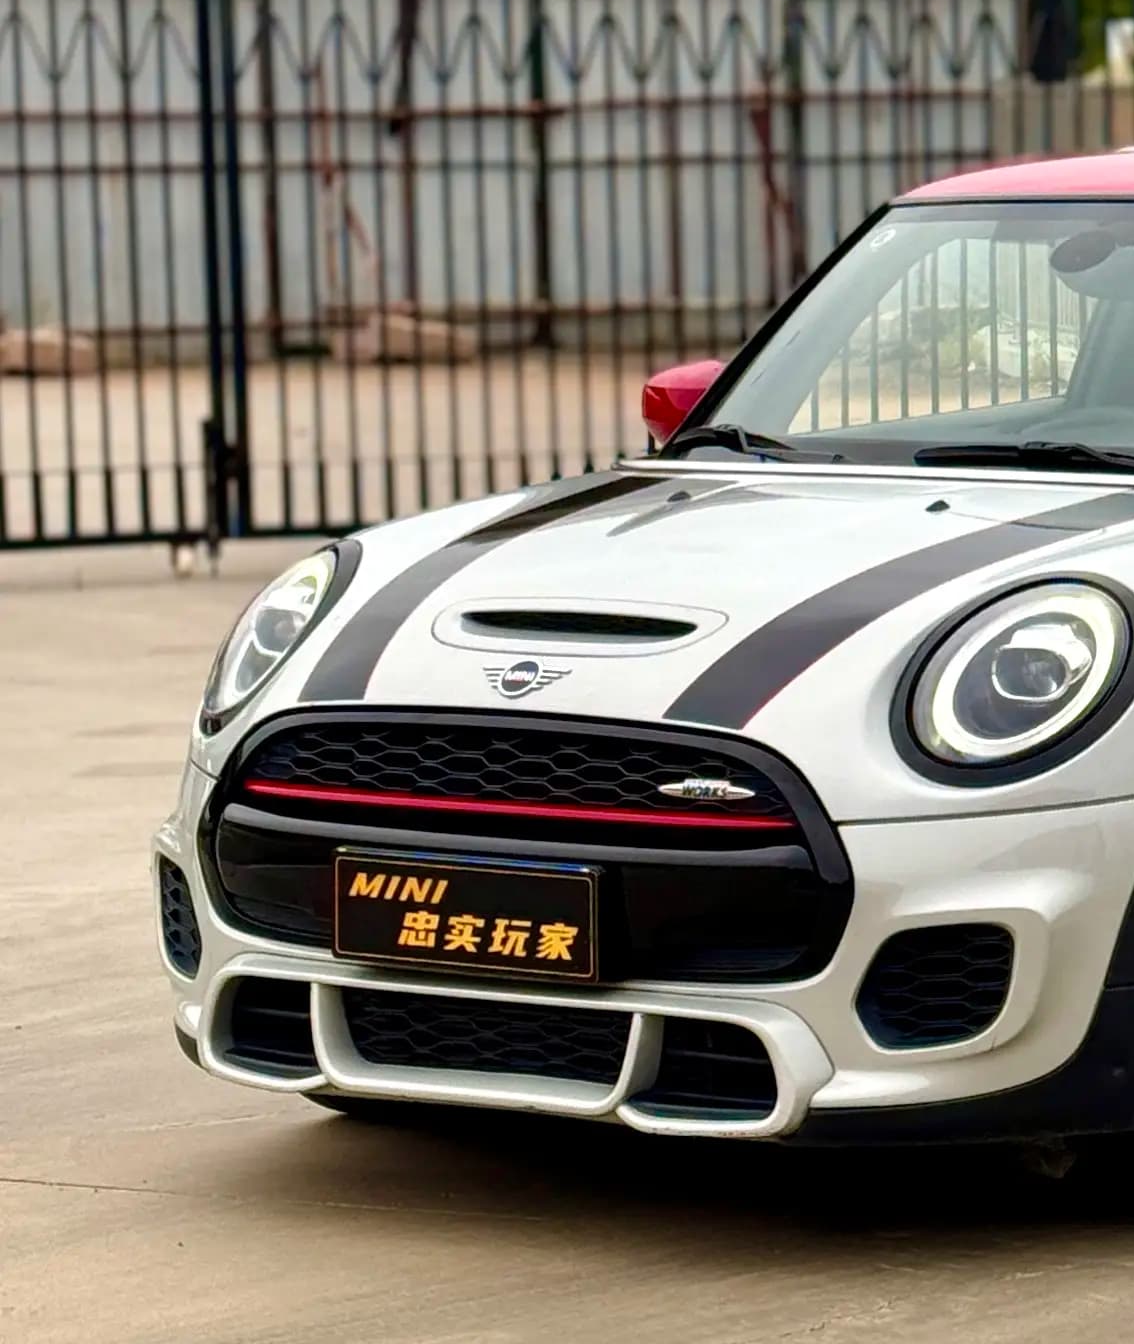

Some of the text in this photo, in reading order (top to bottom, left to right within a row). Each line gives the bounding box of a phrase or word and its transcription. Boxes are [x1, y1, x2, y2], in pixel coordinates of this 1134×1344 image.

[349, 872, 448, 905] MINI
[397, 910, 579, 961] 忠实玩家
